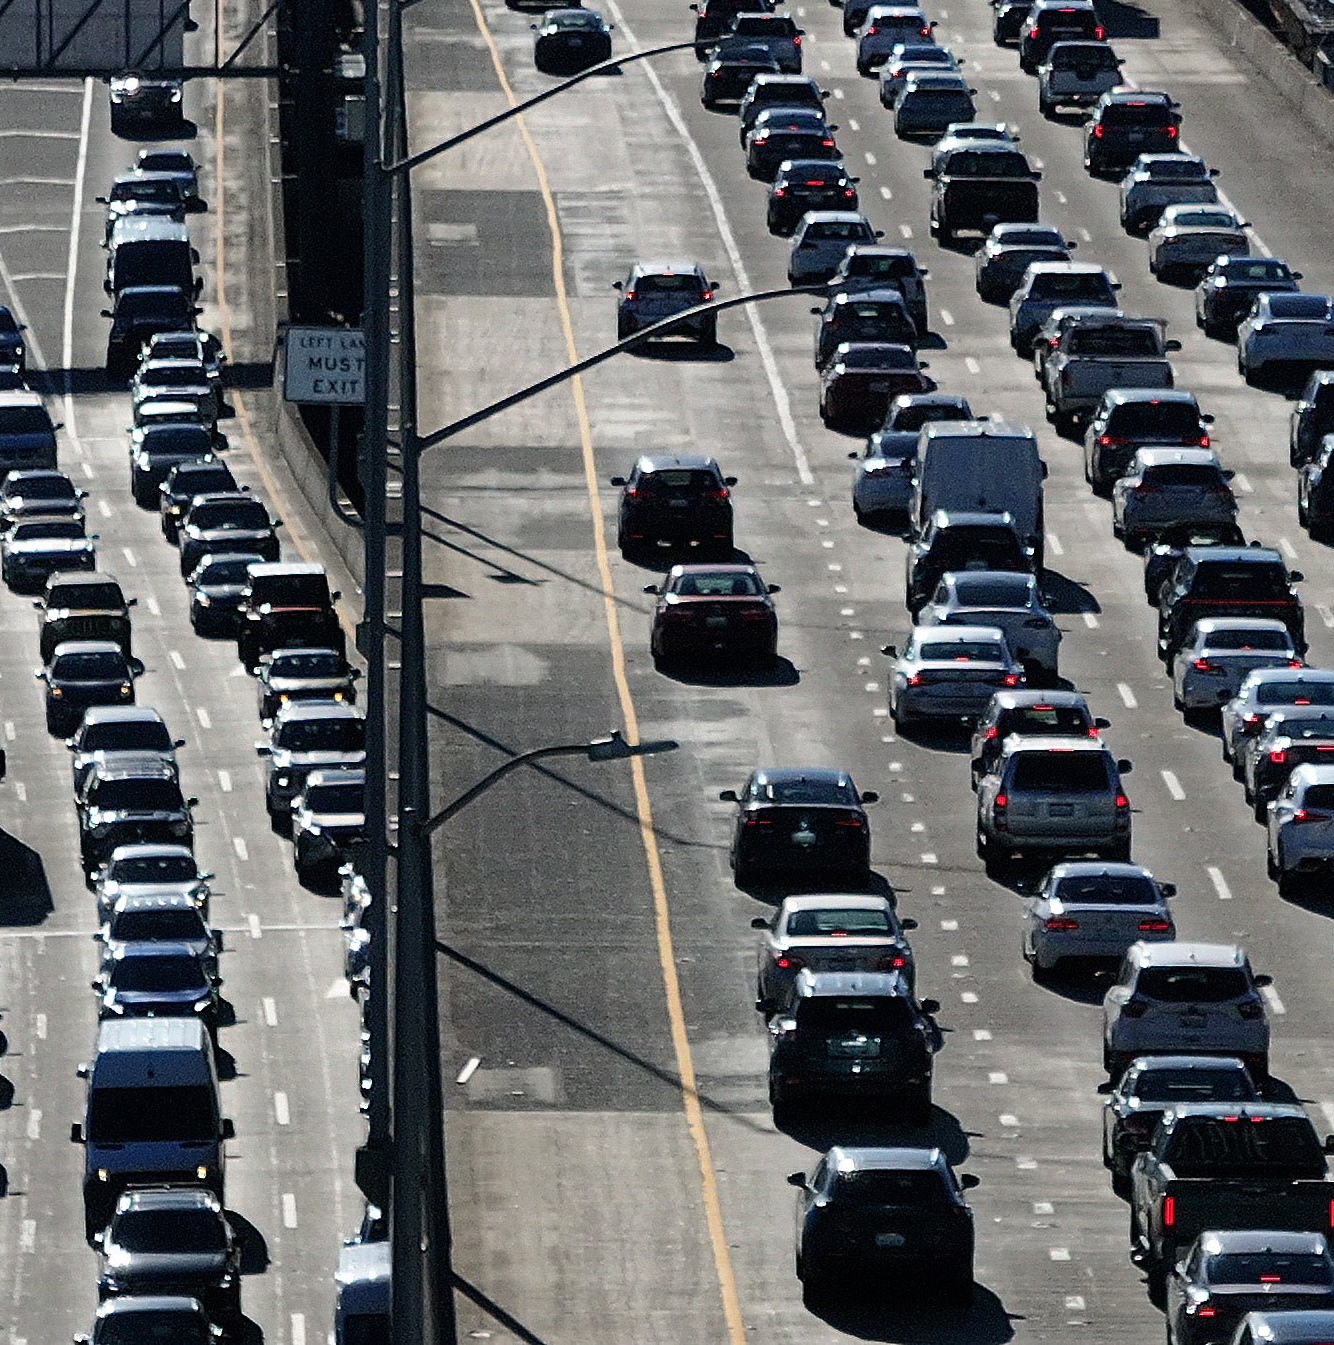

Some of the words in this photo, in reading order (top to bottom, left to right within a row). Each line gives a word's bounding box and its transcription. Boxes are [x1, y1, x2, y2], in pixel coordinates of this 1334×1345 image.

[300, 337, 332, 349] LEFT
[308, 357, 365, 372] MUST
[313, 379, 357, 394] EXIT
